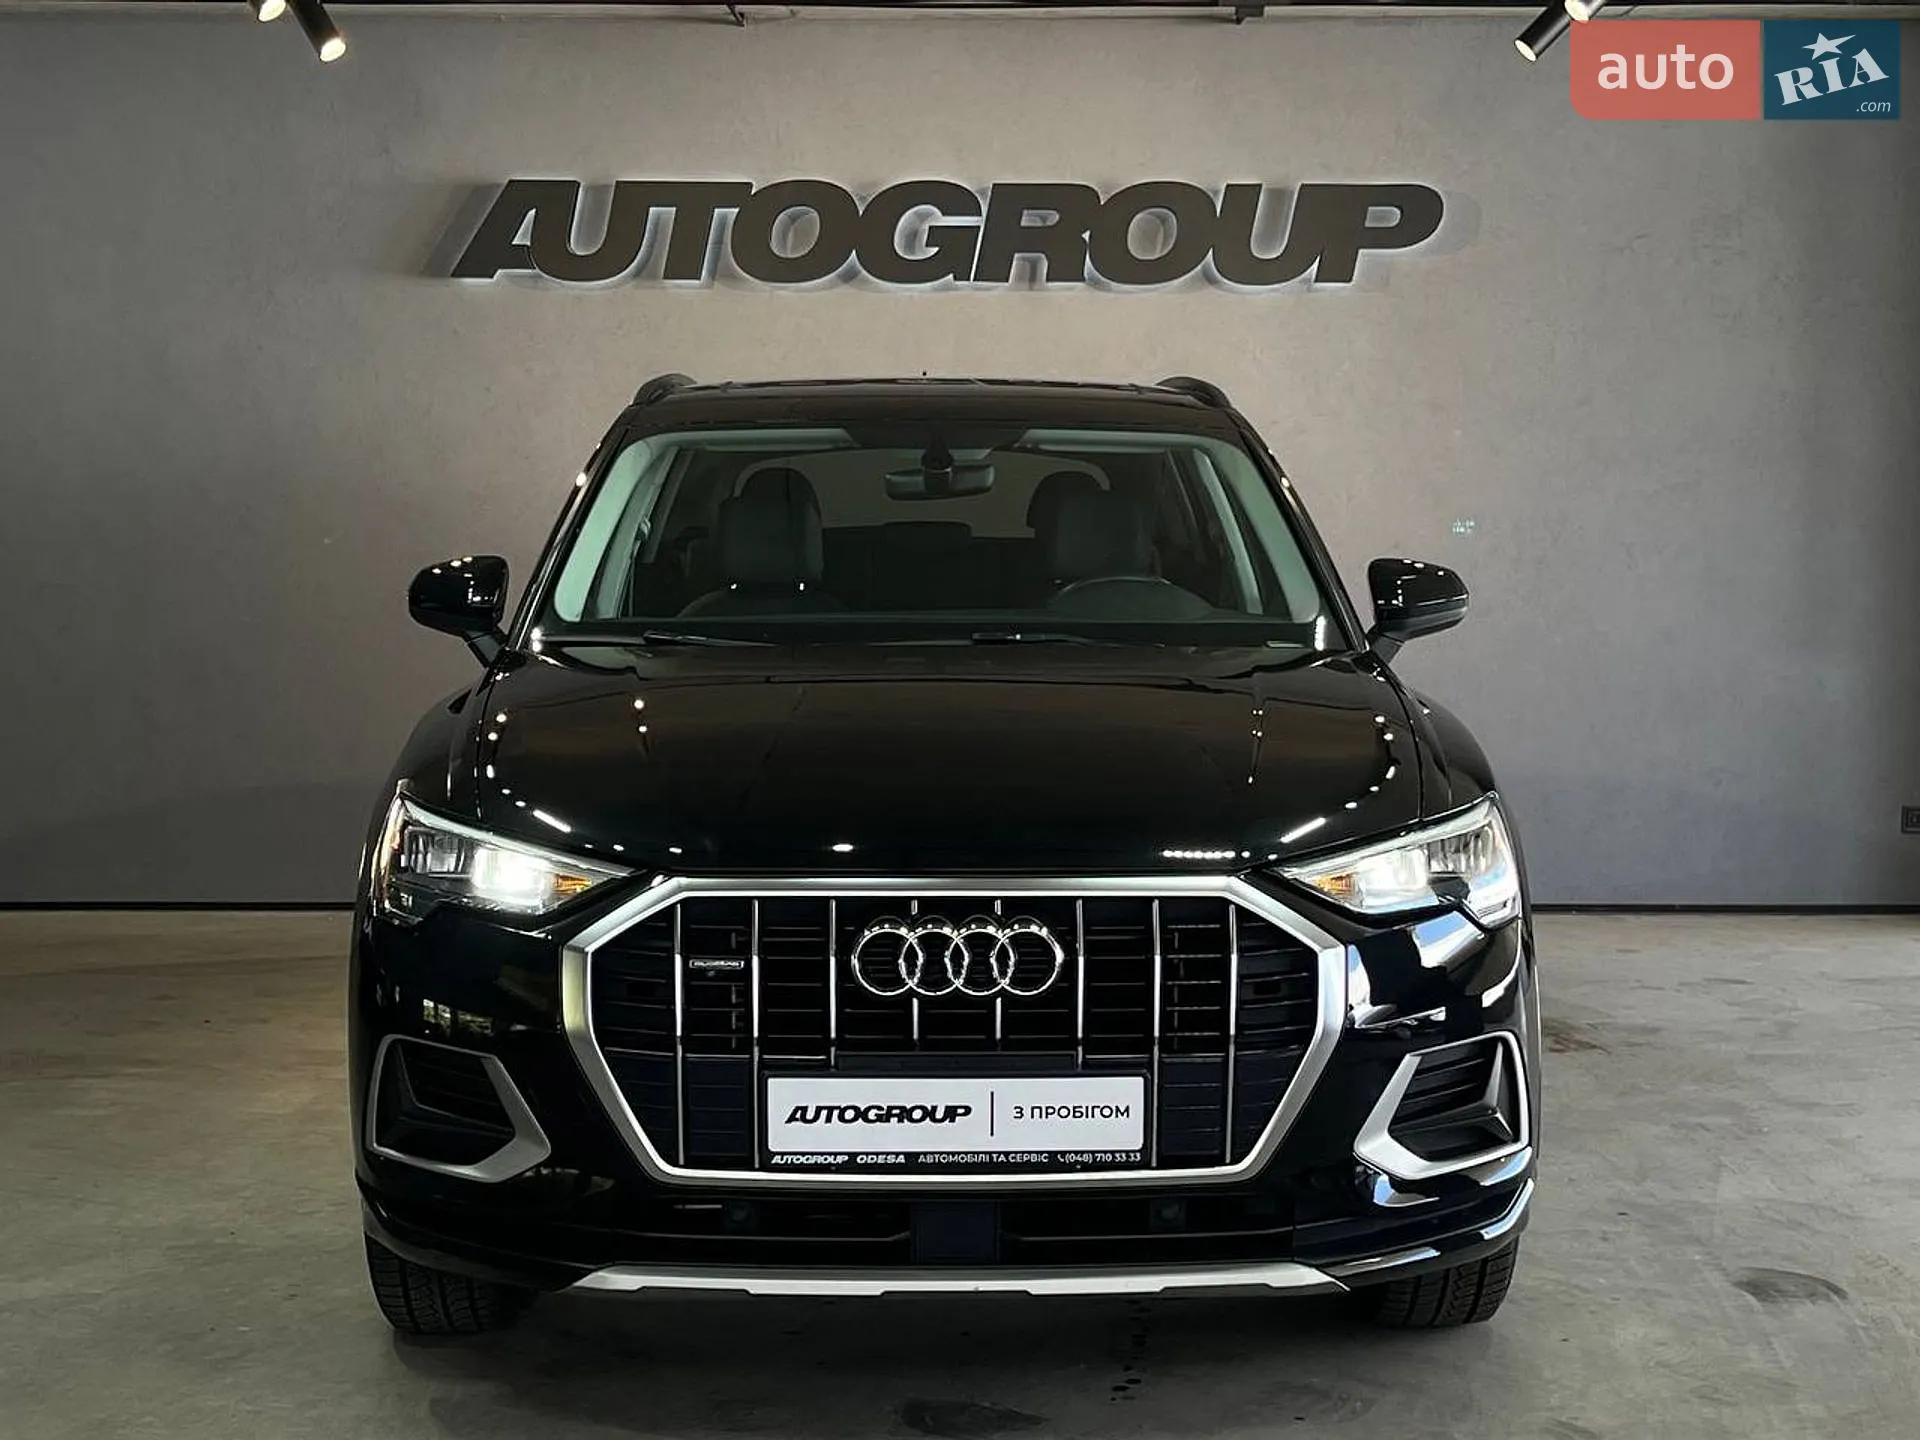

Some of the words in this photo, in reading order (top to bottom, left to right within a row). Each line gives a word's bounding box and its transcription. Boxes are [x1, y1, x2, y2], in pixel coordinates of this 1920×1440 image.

[451, 178, 1443, 284] AUTOGROUP
[785, 1105, 972, 1124] AUTOGROUP
[1030, 1105, 1130, 1119] ПРОБІГОМ
[771, 1154, 849, 1164] AUTOGROUP
[856, 1154, 906, 1164] ODESA
